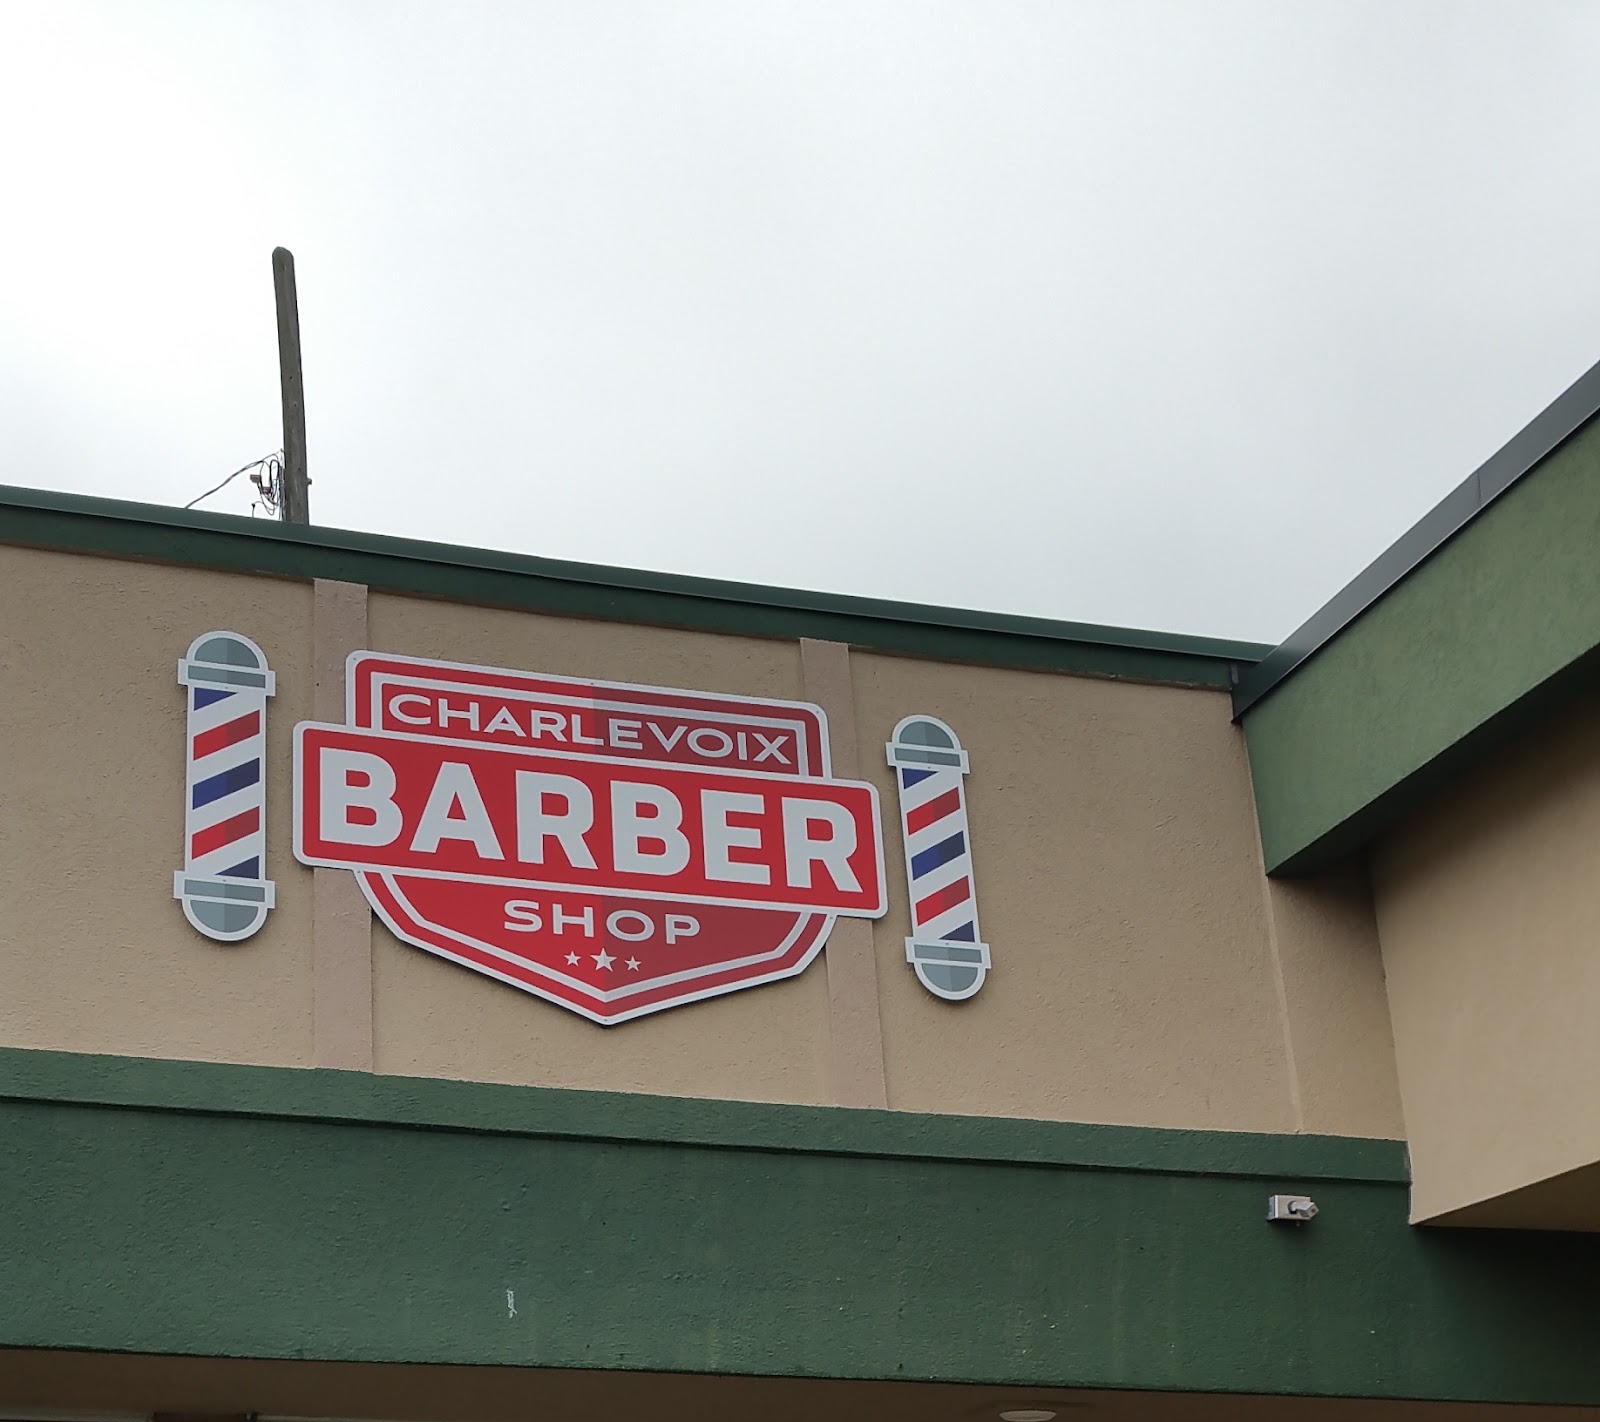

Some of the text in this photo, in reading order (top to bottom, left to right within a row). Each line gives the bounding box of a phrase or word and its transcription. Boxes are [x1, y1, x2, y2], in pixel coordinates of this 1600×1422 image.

[388, 693, 792, 765] CHARLEVOIX
[318, 747, 864, 894] BARBER
[503, 899, 701, 945] SHOP
